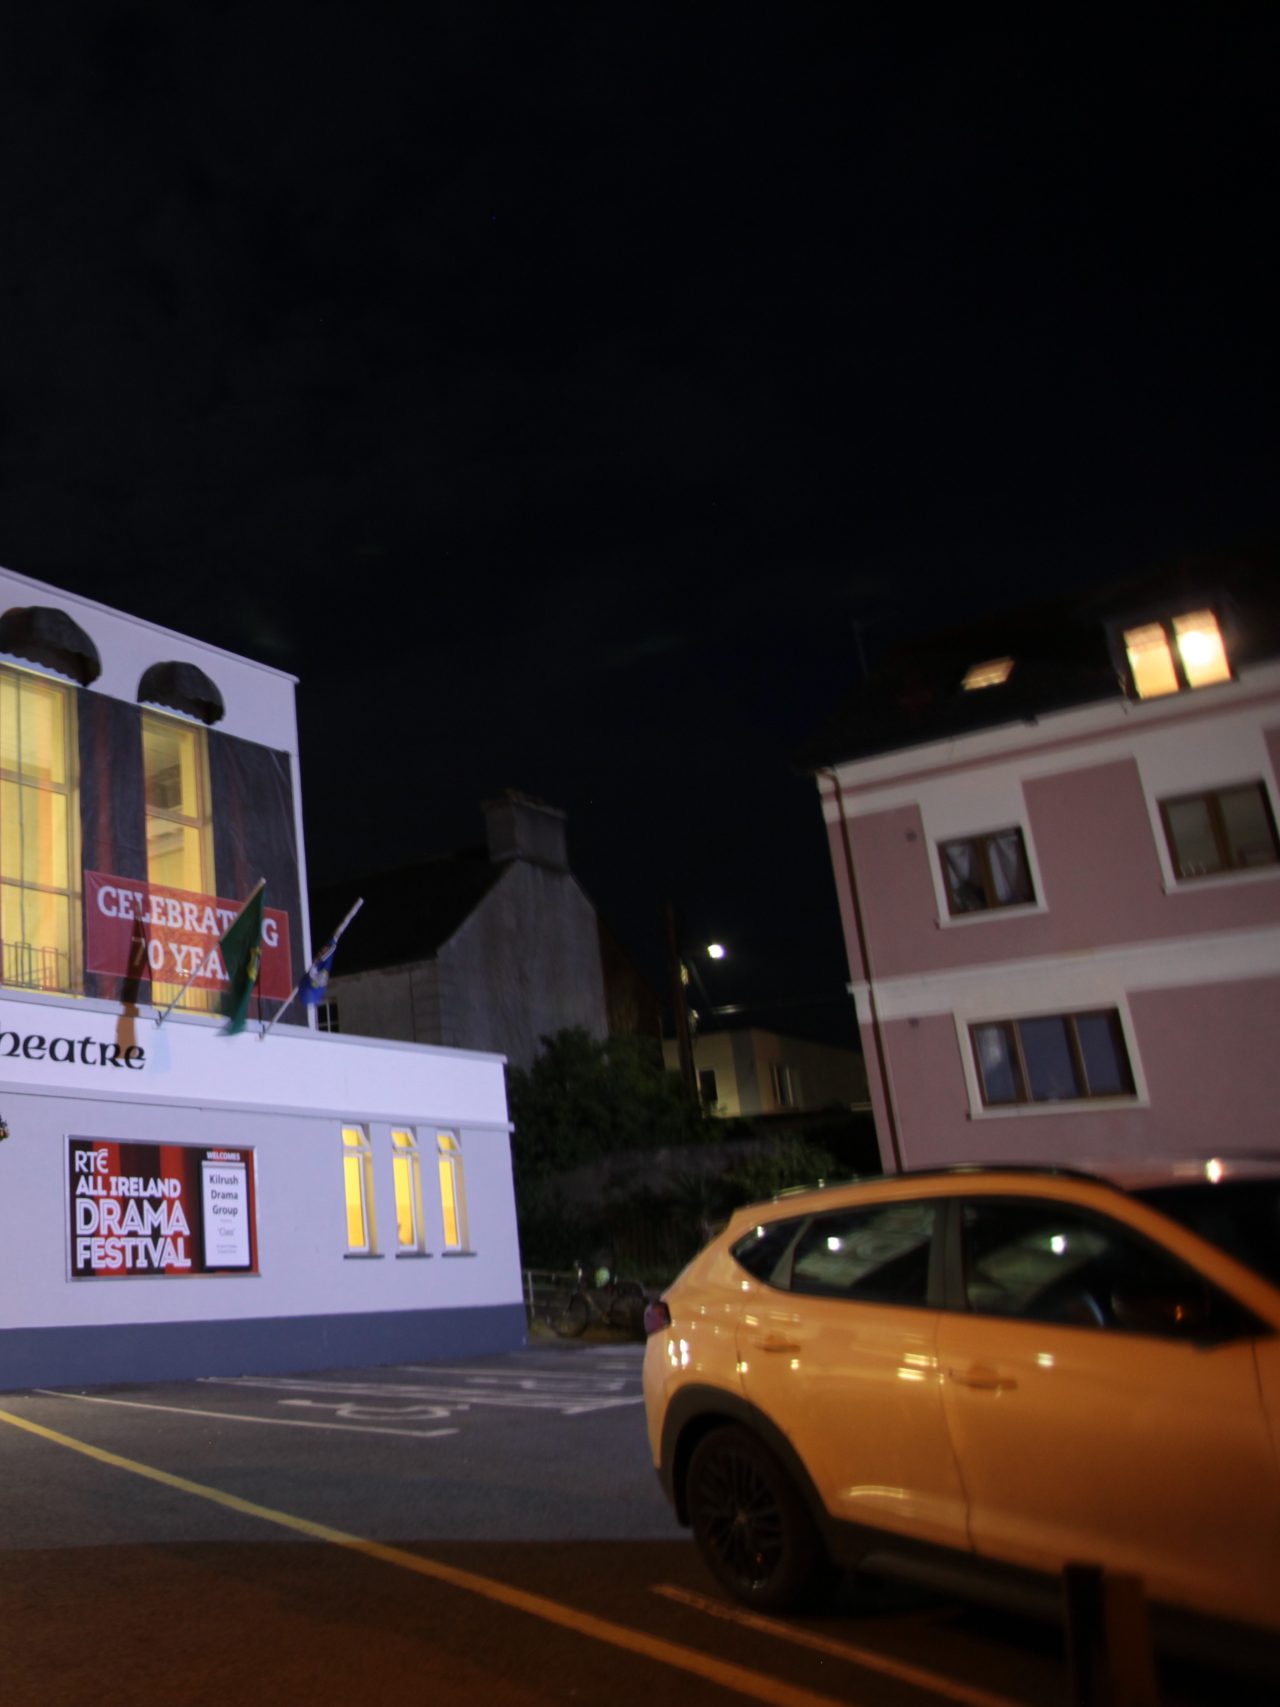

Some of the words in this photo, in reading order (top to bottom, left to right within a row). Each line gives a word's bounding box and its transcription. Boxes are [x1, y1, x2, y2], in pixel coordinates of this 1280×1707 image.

[97, 885, 279, 948] CELEBRATG
[168, 942, 230, 981] YEA
[206, 1150, 241, 1161] WELCOMES
[76, 1174, 108, 1195] ALL
[109, 1176, 182, 1198] IRELAND
[209, 1174, 239, 1186] Kilrush
[211, 1190, 239, 1200] Drama
[75, 1197, 191, 1236] DRAMA
[212, 1204, 239, 1217] Group
[76, 1236, 192, 1269] FESTIVAL
